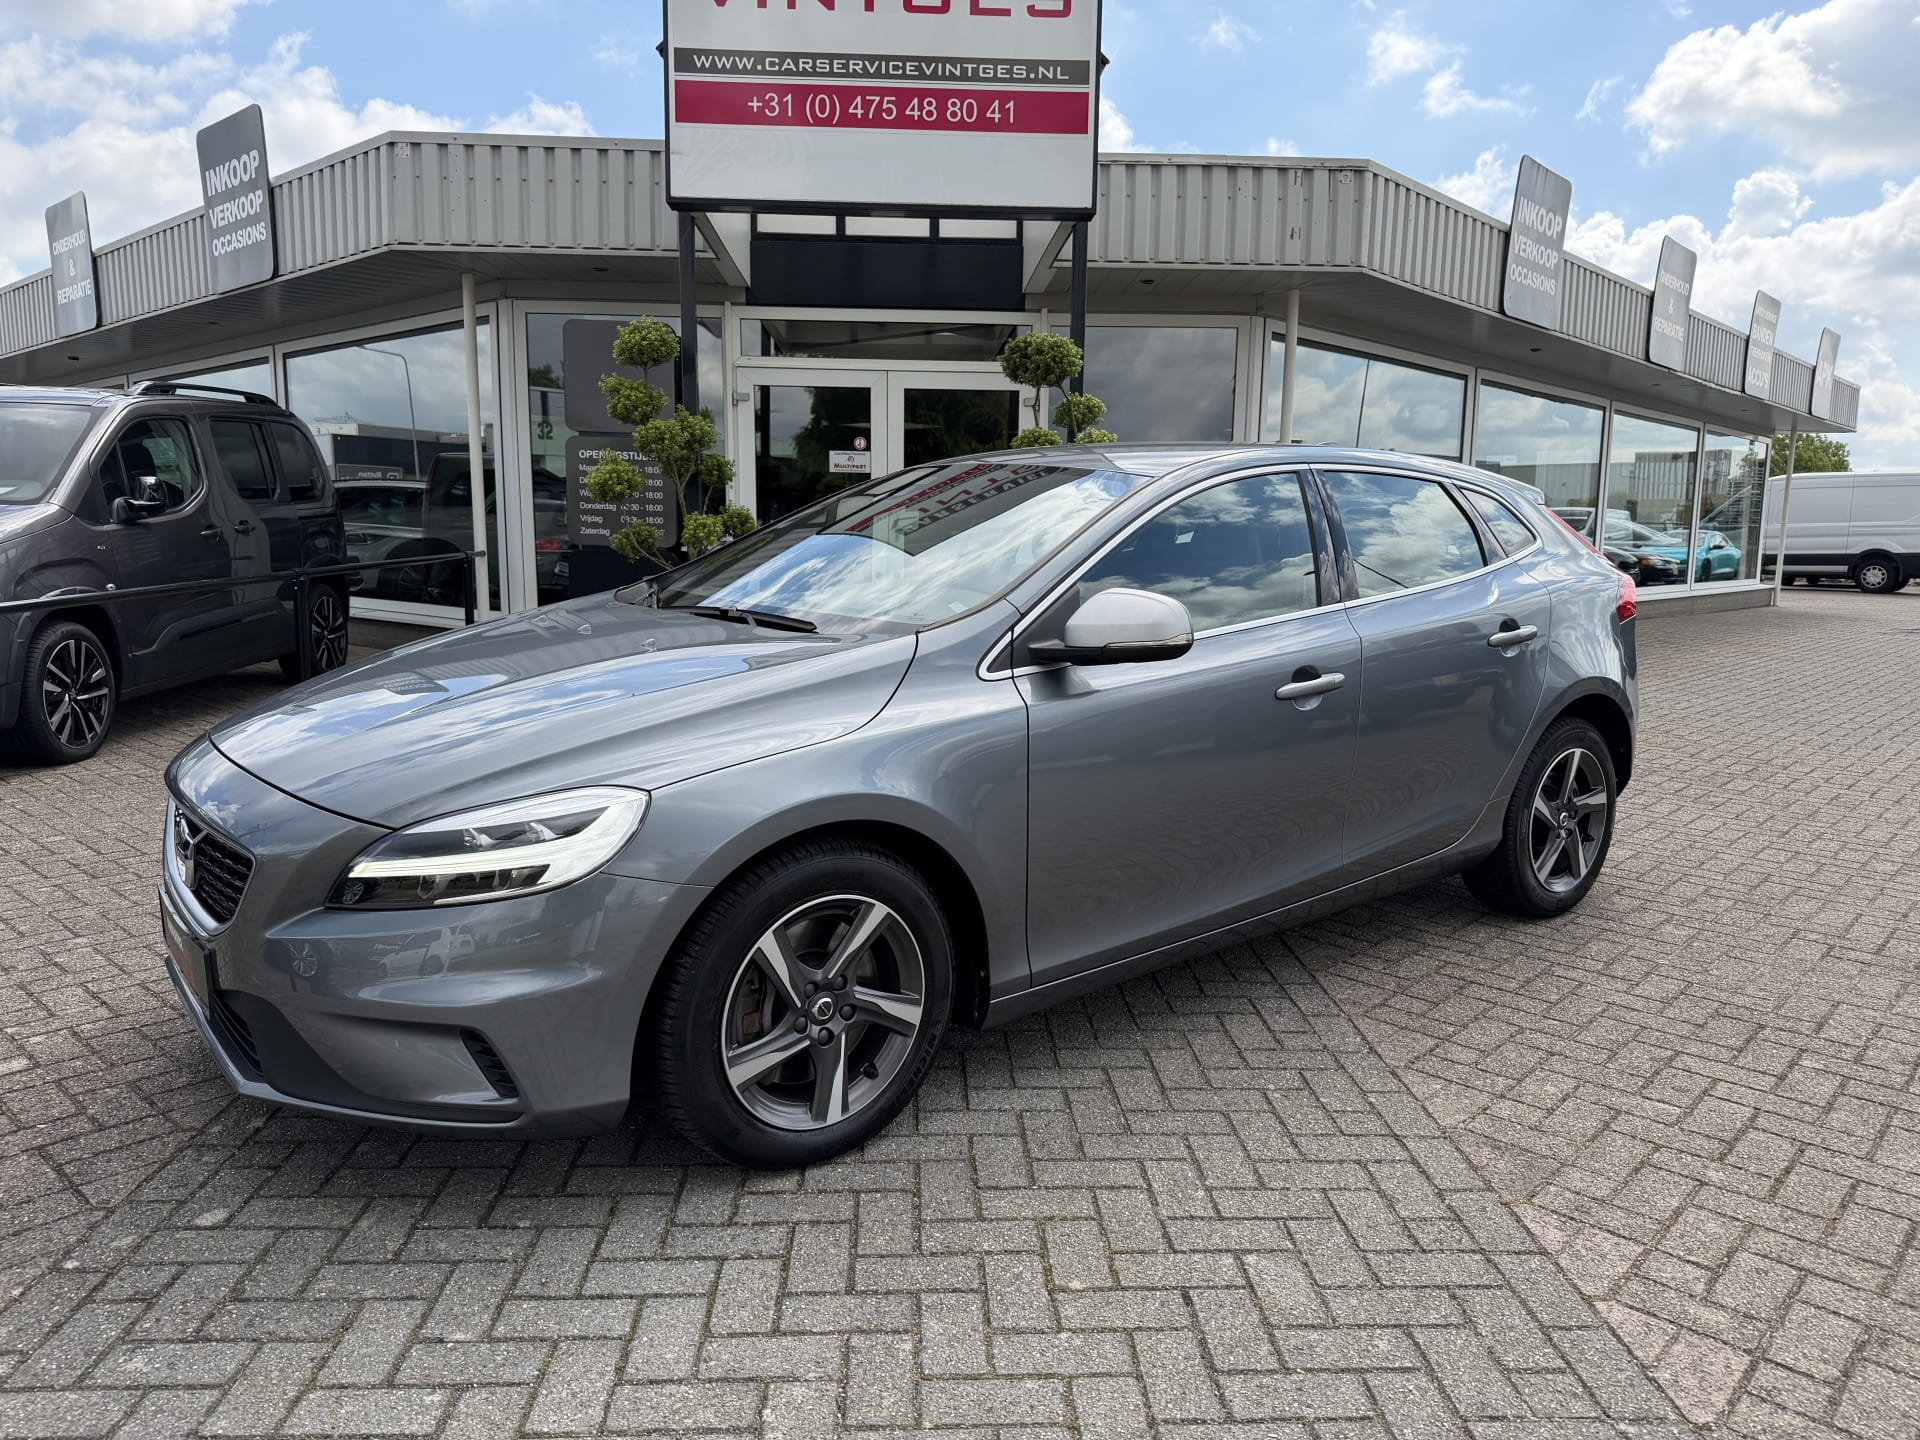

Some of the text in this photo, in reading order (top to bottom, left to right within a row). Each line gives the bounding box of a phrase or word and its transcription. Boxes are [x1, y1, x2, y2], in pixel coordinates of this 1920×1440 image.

[693, 54, 1070, 80] WWW.CARSERVICEVINTGES.NL
[747, 93, 1016, 124] +31 (0) 475 48 80 41
[205, 149, 260, 197] INKOOP
[209, 189, 264, 229] VERKOOP
[1517, 196, 1563, 240] INKOOP
[52, 229, 86, 256] ONDERHOUD
[212, 222, 267, 257] OCCASIONS
[1513, 235, 1559, 270] VERKOOP
[69, 259, 76, 277] &
[1510, 264, 1556, 296] OCCASIONS
[57, 278, 92, 305] REPARATIE
[1659, 269, 1690, 297] ONDERHOUD
[1653, 317, 1685, 342] REPARATIE
[537, 421, 553, 440] 32
[580, 501, 617, 511] Donderdag
[580, 514, 603, 524] Vrijdag
[580, 526, 611, 536] Zaterdag
